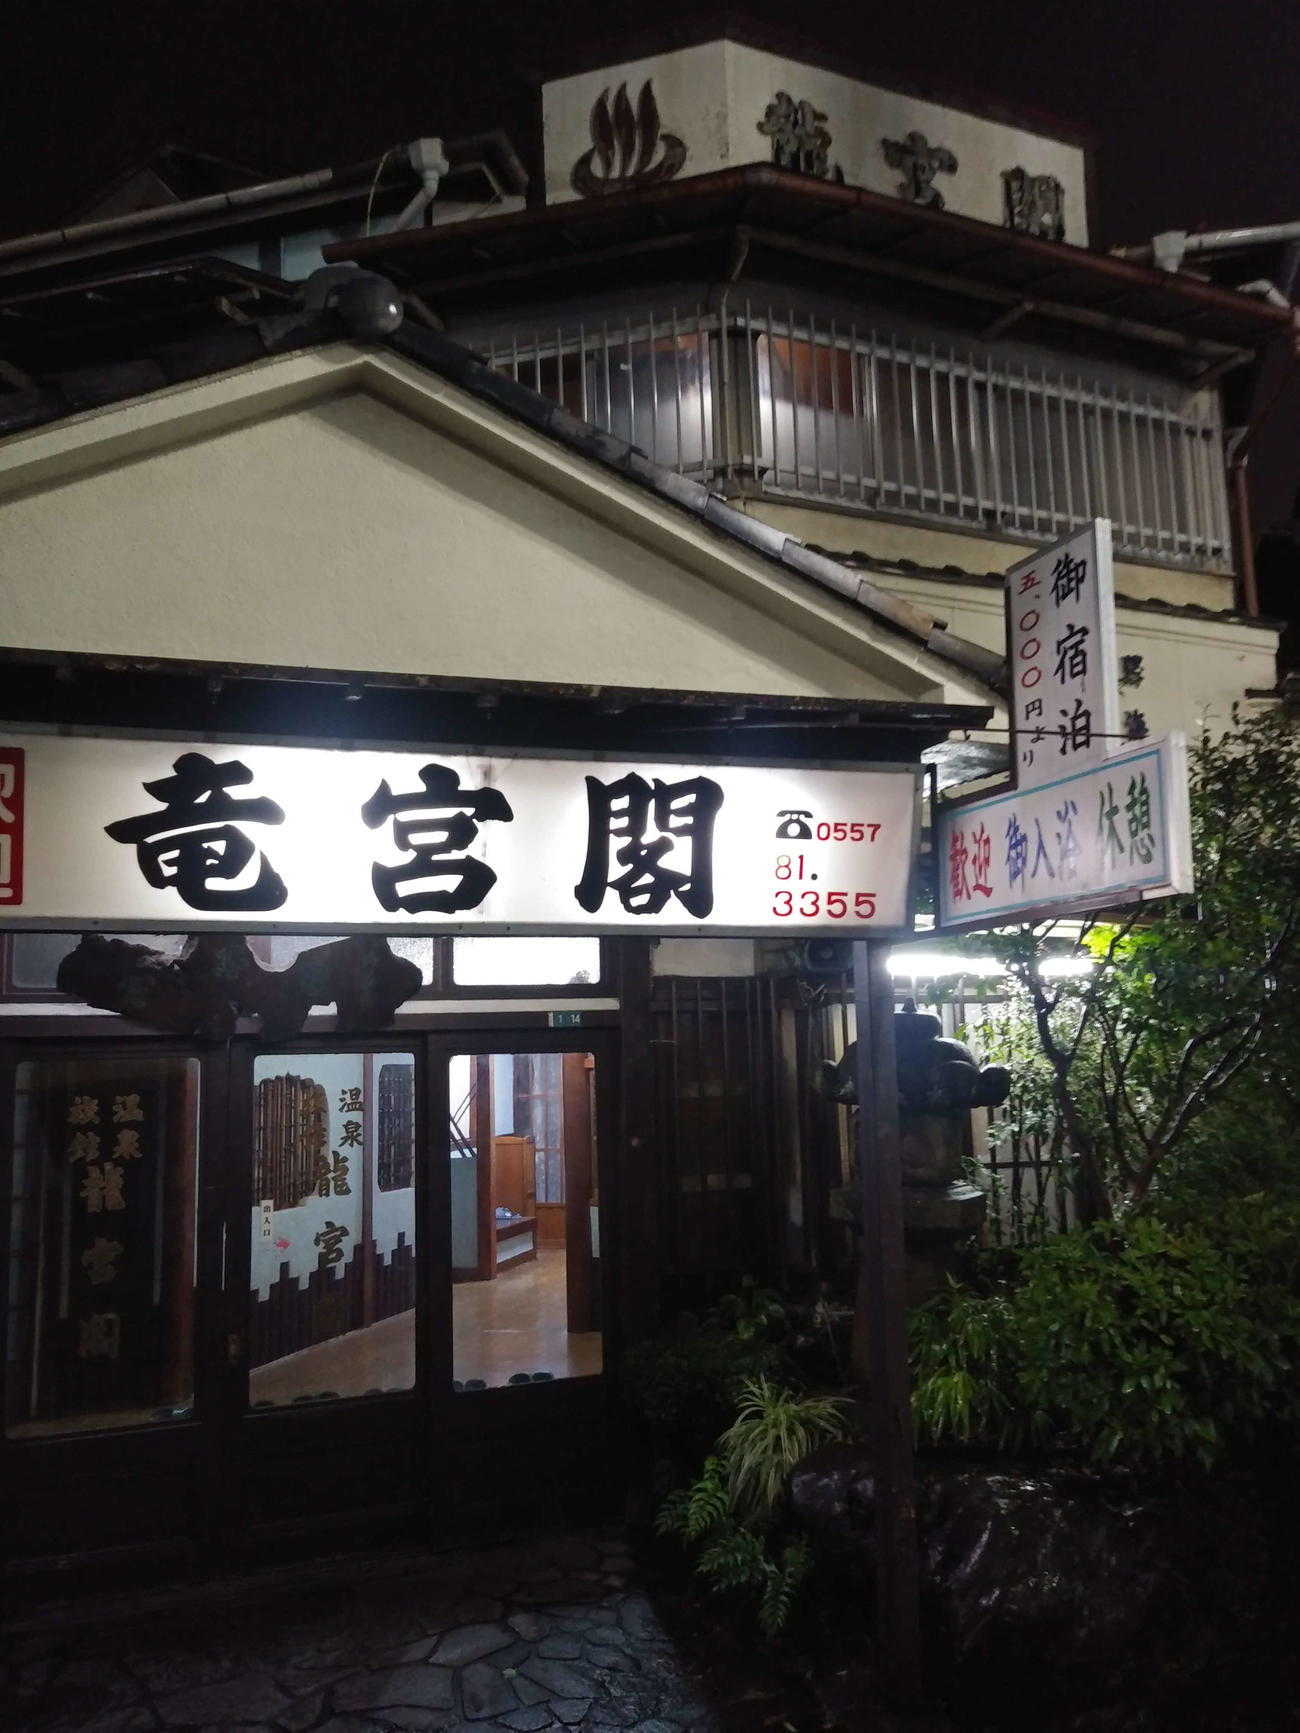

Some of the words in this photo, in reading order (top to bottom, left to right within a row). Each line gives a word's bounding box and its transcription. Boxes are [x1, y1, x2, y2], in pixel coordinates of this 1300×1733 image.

[1050, 553, 1092, 756] 御宿泊
[104, 752, 724, 919] 竜宮閣
[816, 822, 881, 842] 0557
[1098, 771, 1155, 872] 休憩
[772, 890, 877, 919] 3355
[338, 1088, 364, 1148] 温泉
